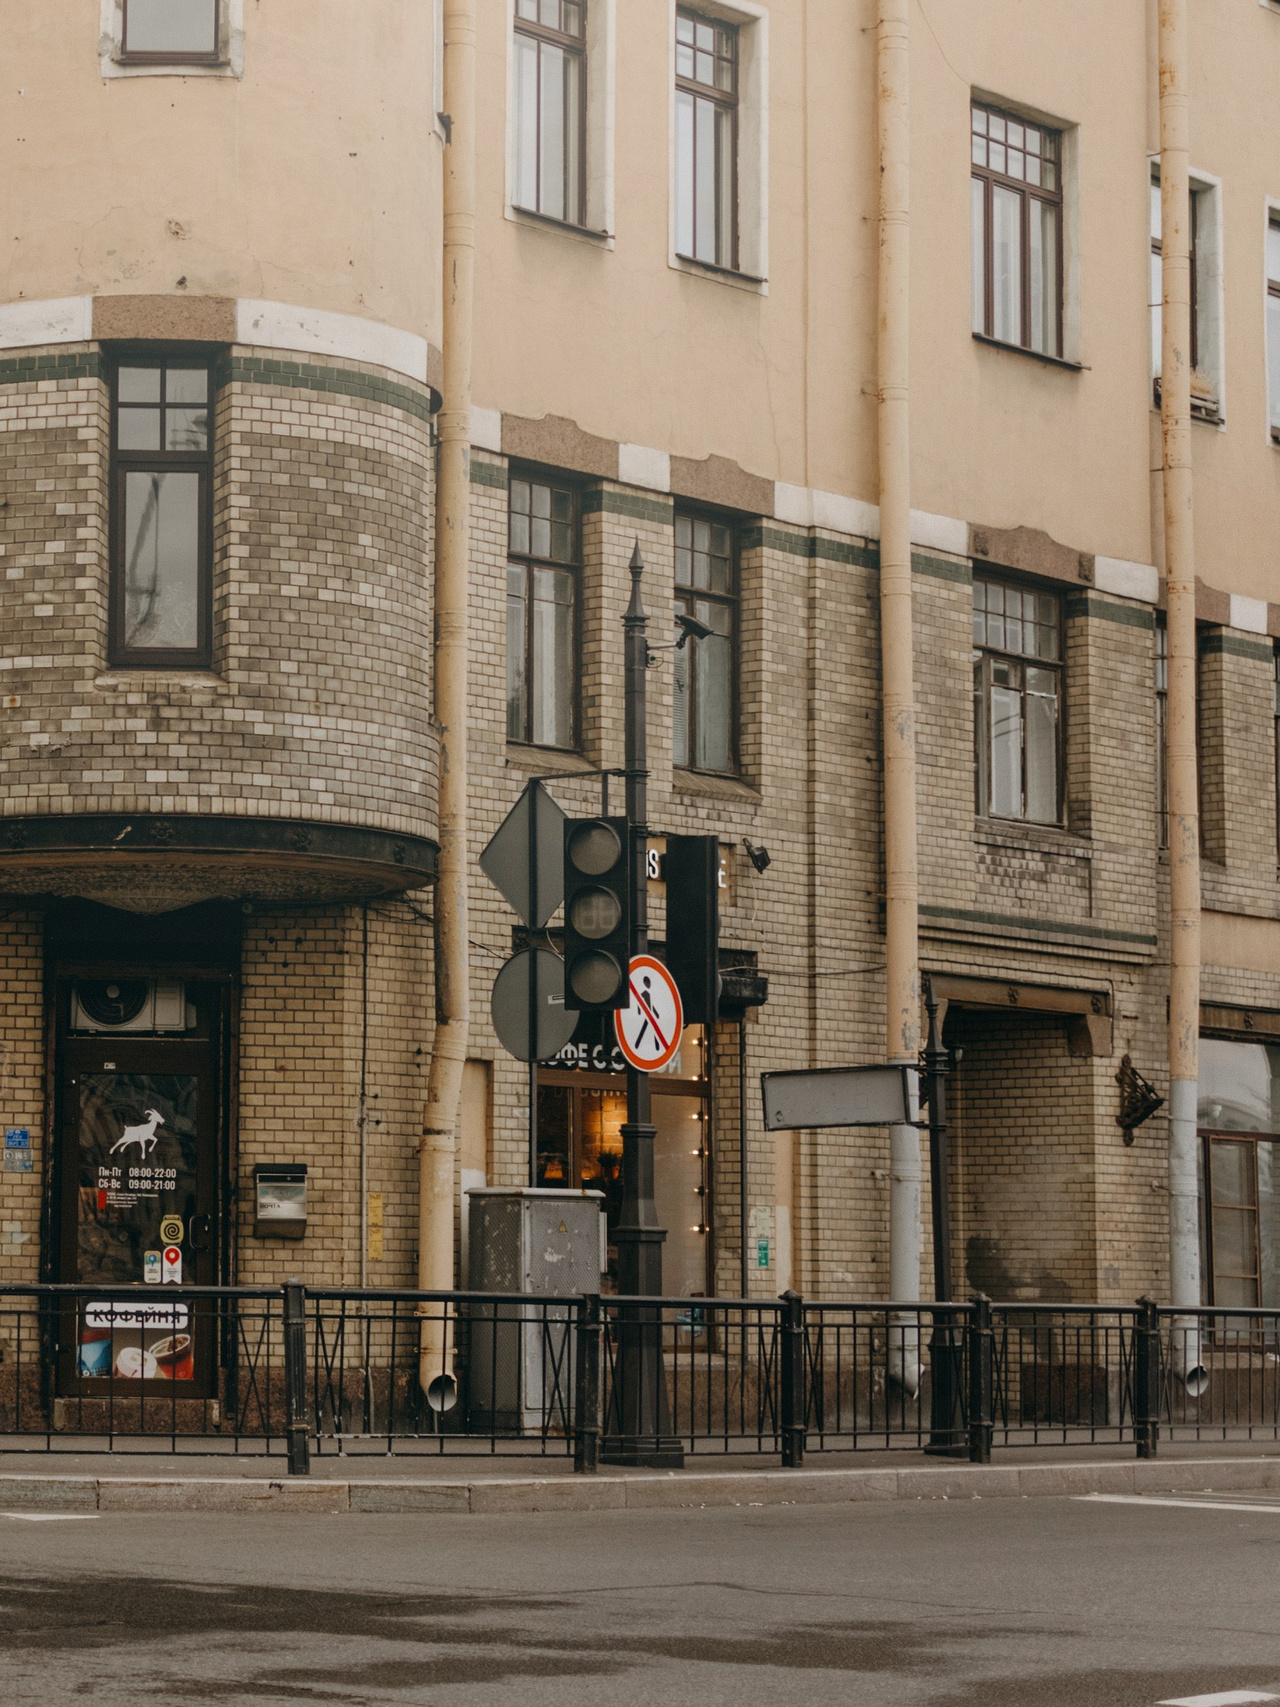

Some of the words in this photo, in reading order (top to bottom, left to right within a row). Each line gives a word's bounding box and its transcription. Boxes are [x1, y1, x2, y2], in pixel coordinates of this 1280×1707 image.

[98, 1166, 122, 1177] Пн-Пт
[128, 1167, 177, 1178] 08:00-22:00
[98, 1178, 122, 1189] Сб-Вс
[128, 1179, 176, 1190] 09:00-21:00
